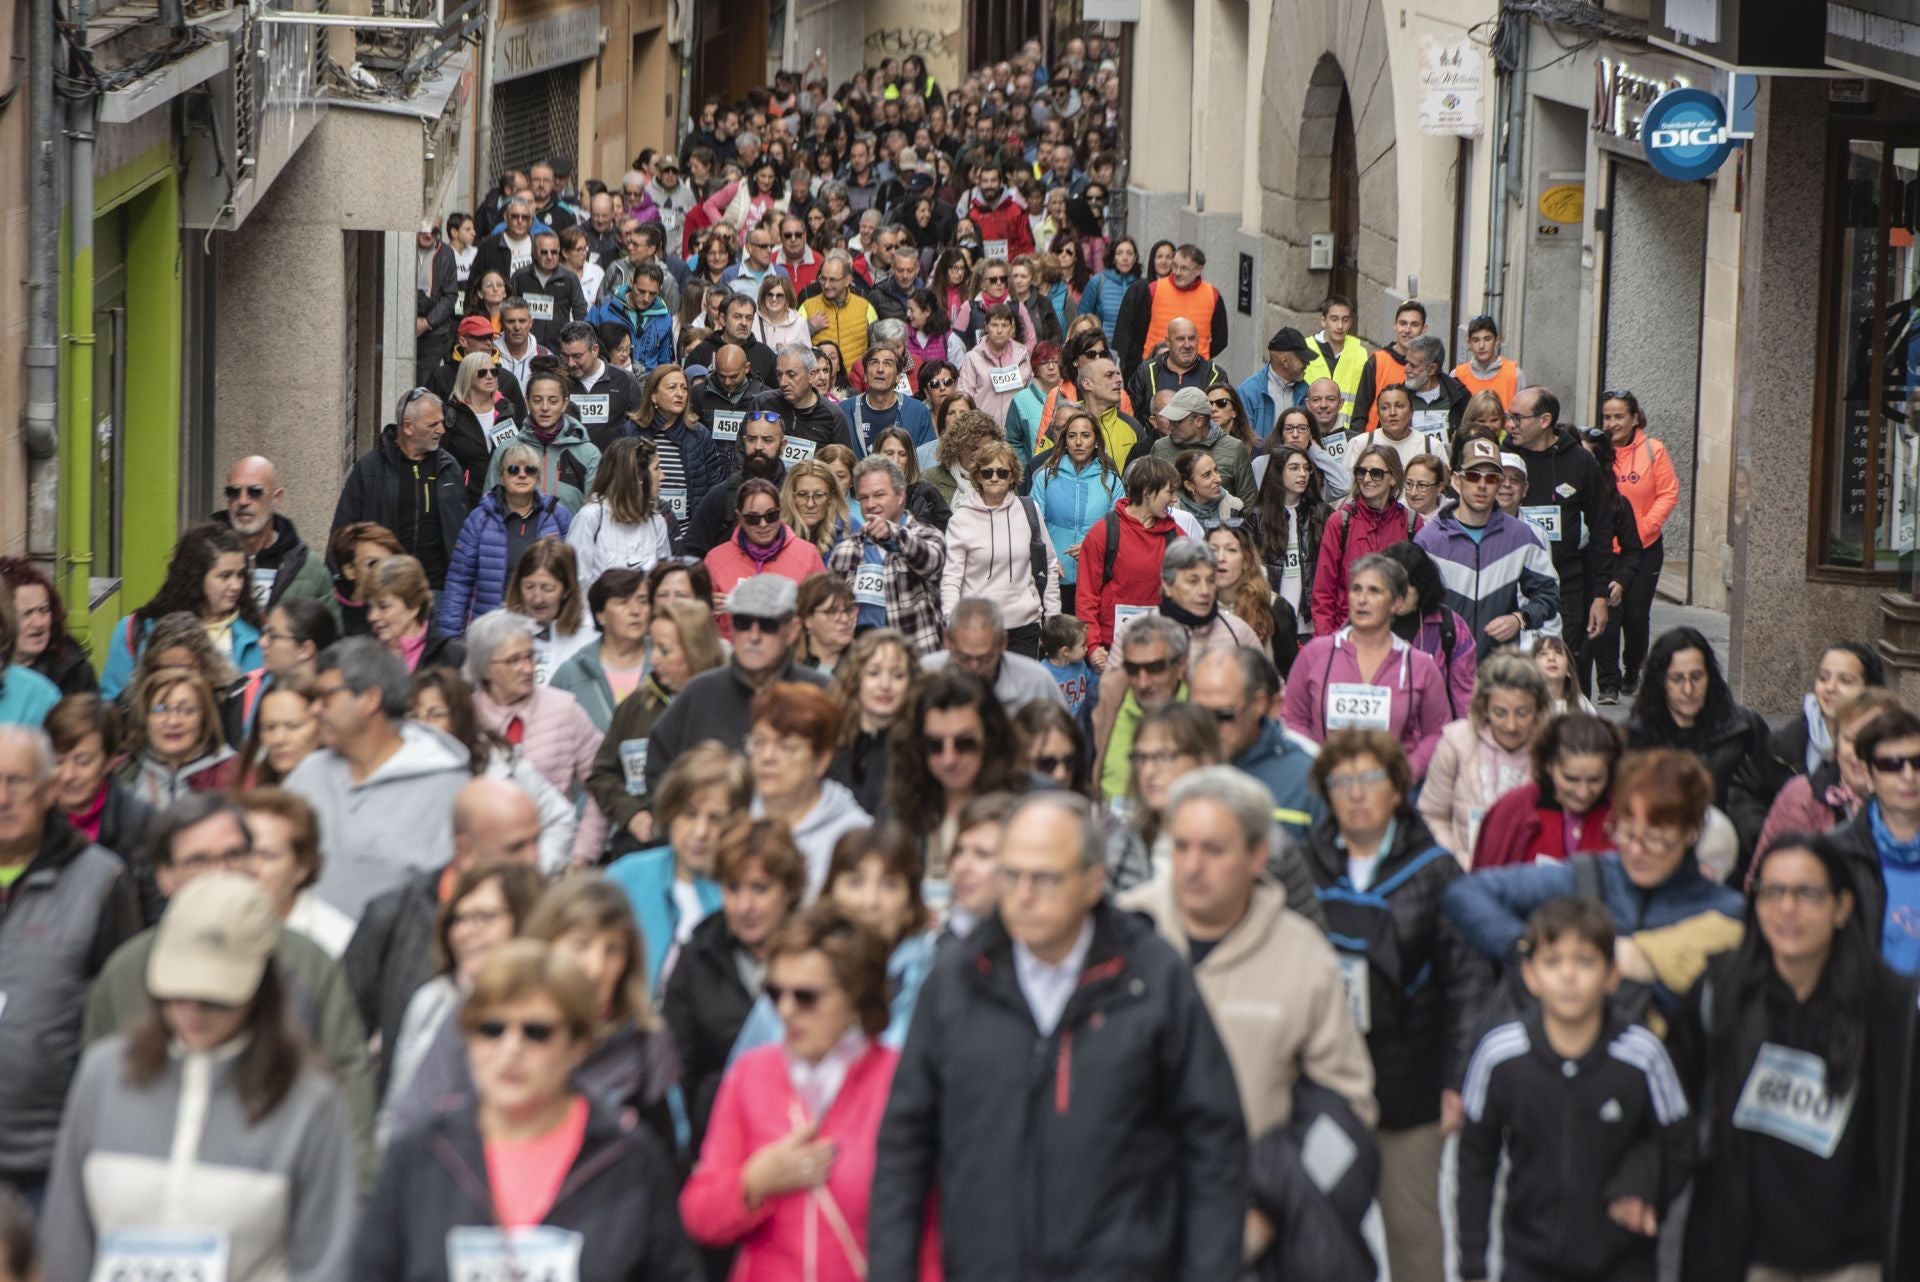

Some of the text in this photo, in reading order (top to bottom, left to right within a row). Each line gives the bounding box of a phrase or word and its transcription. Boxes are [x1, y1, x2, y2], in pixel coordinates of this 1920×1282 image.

[1652, 127, 1727, 148] DIGI
[992, 372, 1017, 386] 6502
[578, 404, 604, 416] 592
[785, 446, 809, 461] 927
[857, 575, 884, 593] 629
[1335, 698, 1382, 715] 6237
